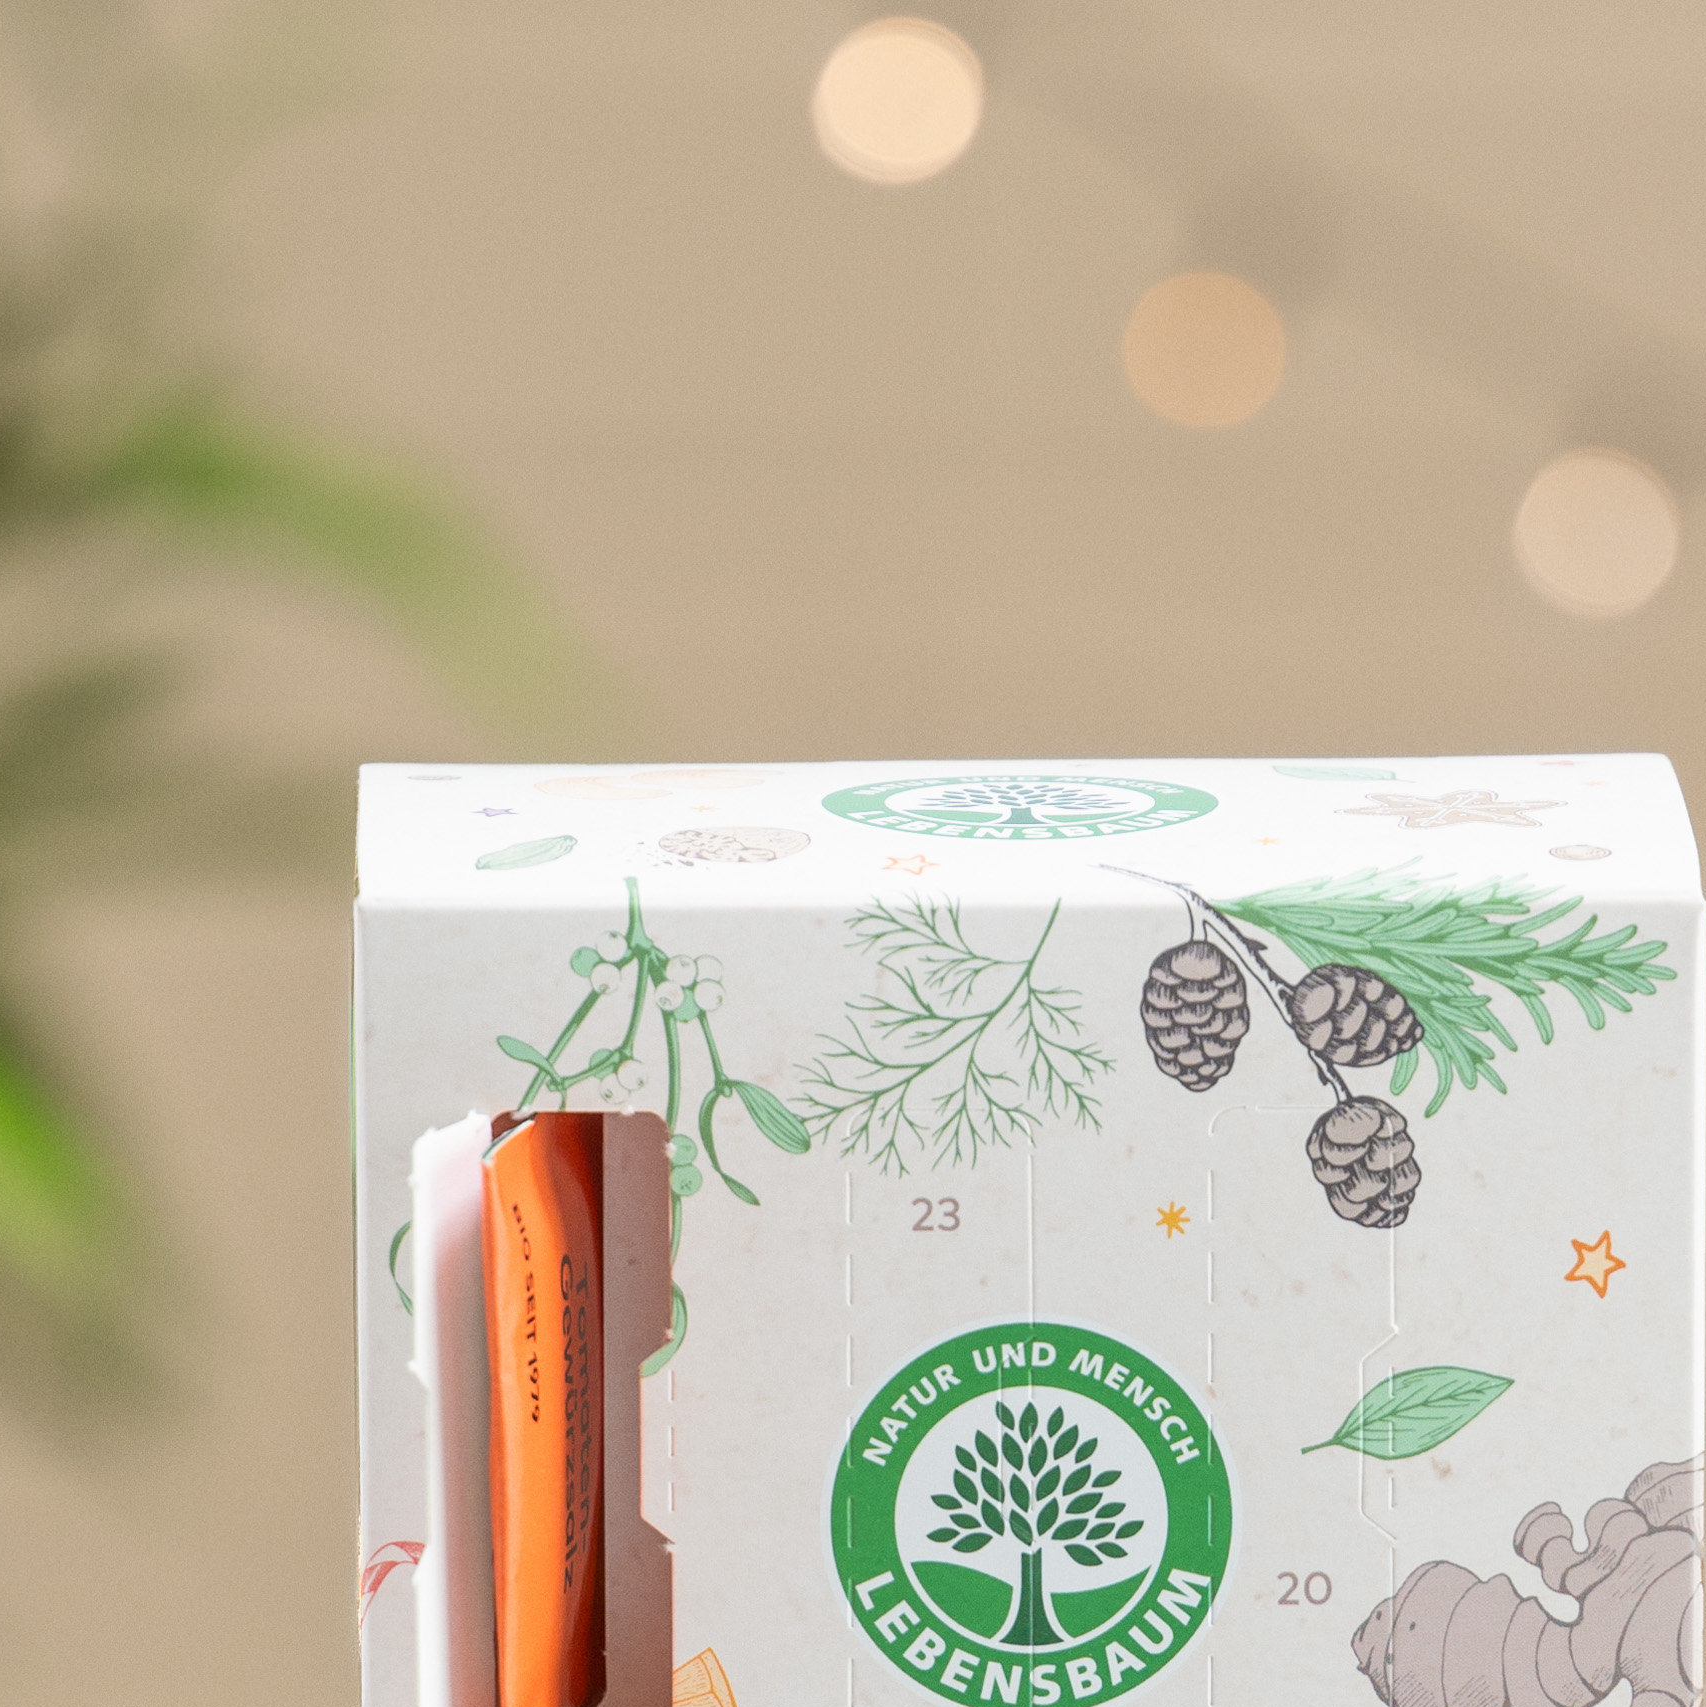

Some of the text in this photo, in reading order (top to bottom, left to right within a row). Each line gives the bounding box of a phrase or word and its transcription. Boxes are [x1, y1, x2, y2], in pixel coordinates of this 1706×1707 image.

[847, 810, 1199, 839] LEBENSBAUM
[912, 1197, 961, 1232] 23
[512, 1204, 540, 1423] BIO SEIT 1979
[560, 1254, 578, 1594] Gewürzsalz
[863, 1341, 1201, 1467] NATUR UND MENSCH
[855, 1567, 1212, 1706] LEBENSBAUM
[1277, 1571, 1333, 1606] 20
